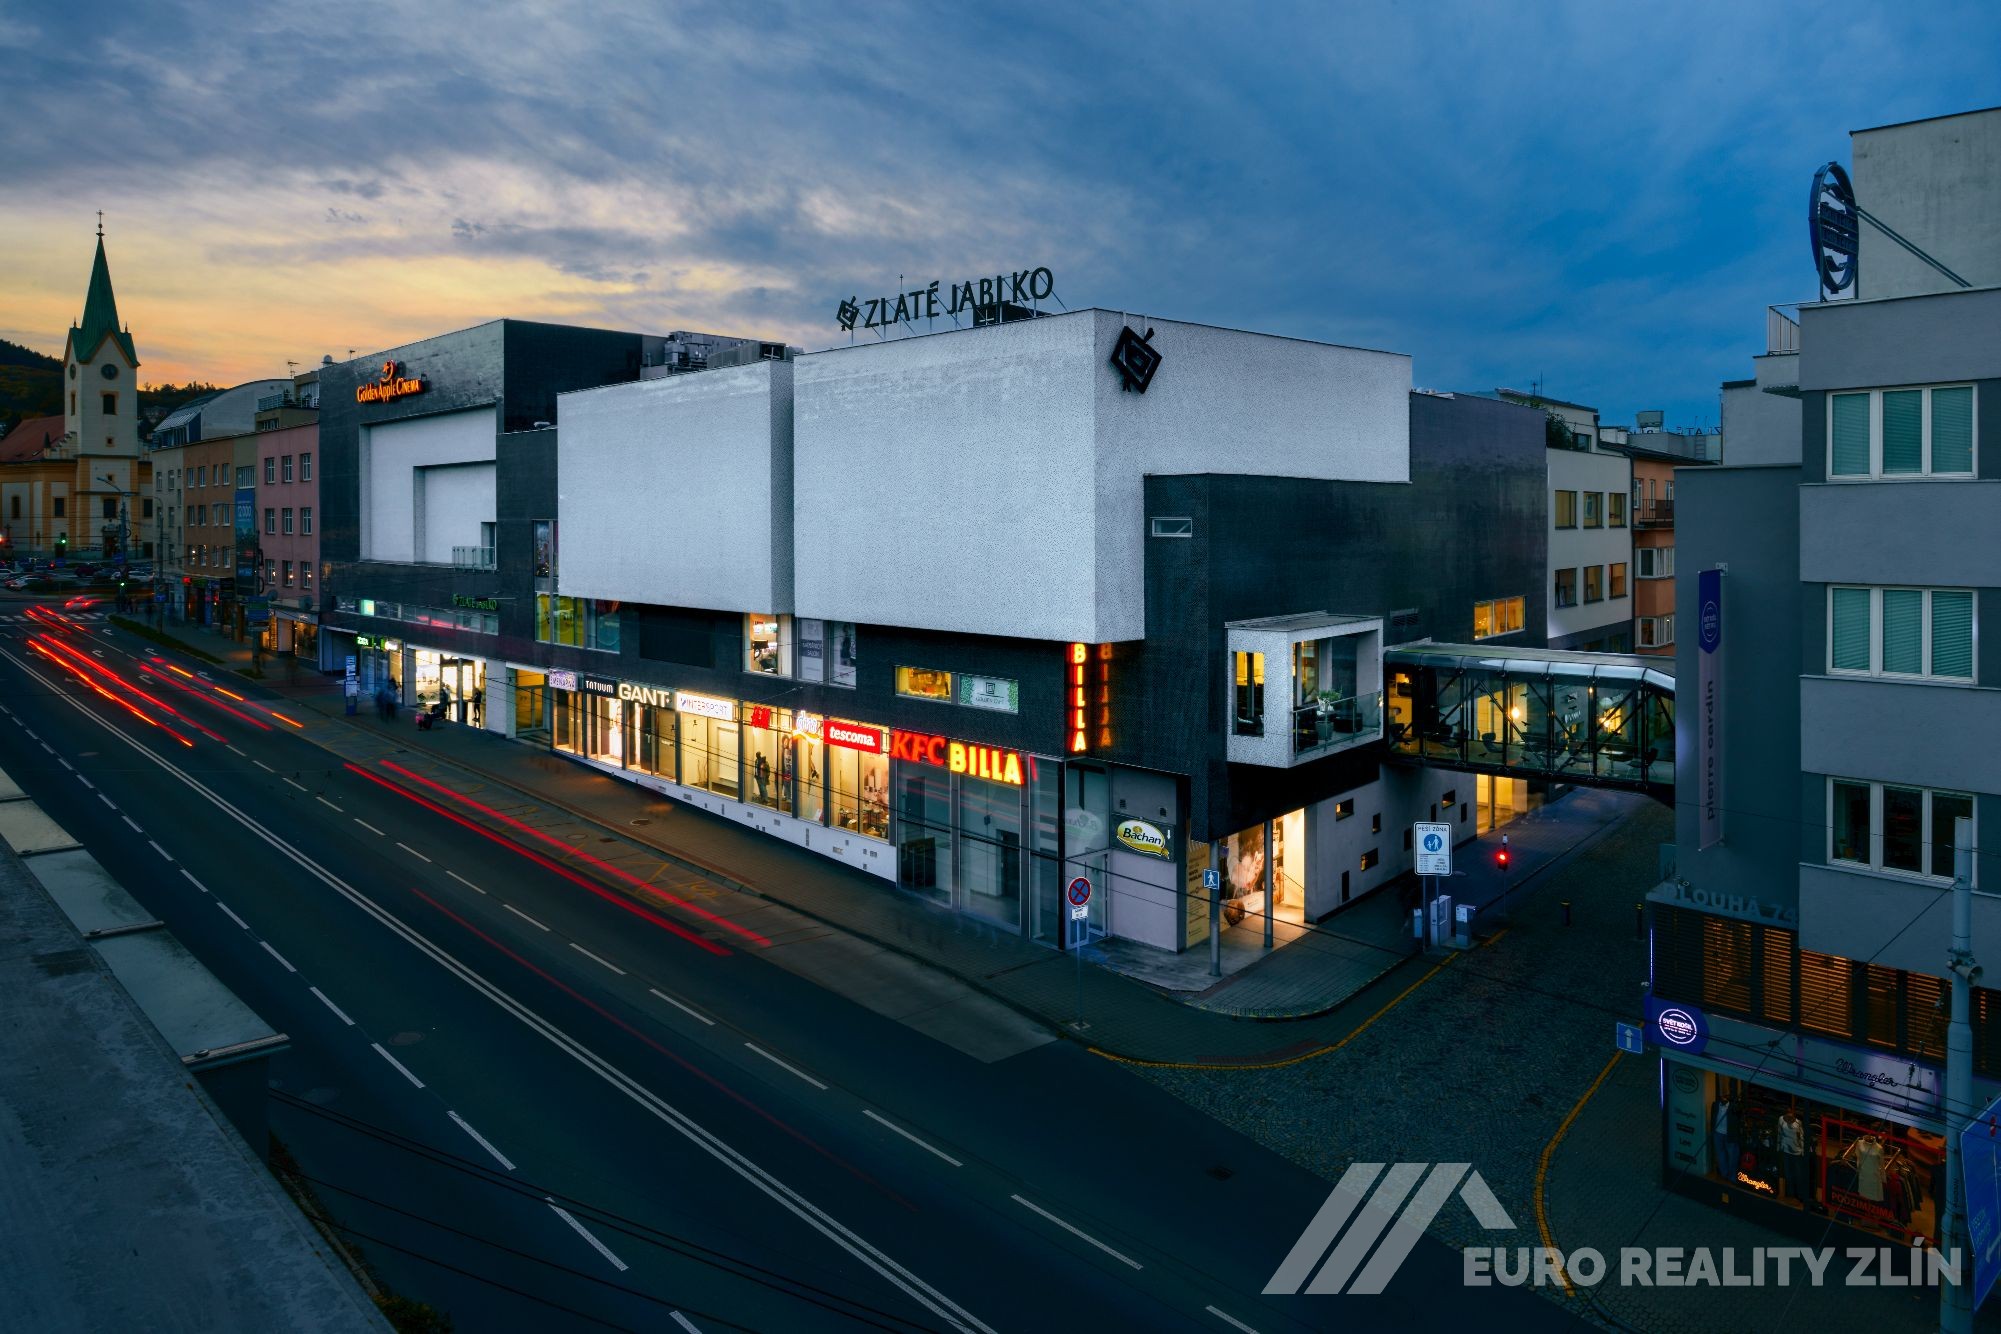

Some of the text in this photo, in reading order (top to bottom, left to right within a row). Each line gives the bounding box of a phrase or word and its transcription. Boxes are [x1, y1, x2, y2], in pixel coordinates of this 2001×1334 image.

[865, 266, 1054, 328] ZLATÉ JABLKO
[618, 683, 670, 708] GANT
[1070, 643, 1087, 752] BILLA
[891, 730, 1025, 786] KFC BILLA
[1122, 827, 1162, 845] Bachan
[1836, 1057, 1898, 1087] Wrangler
